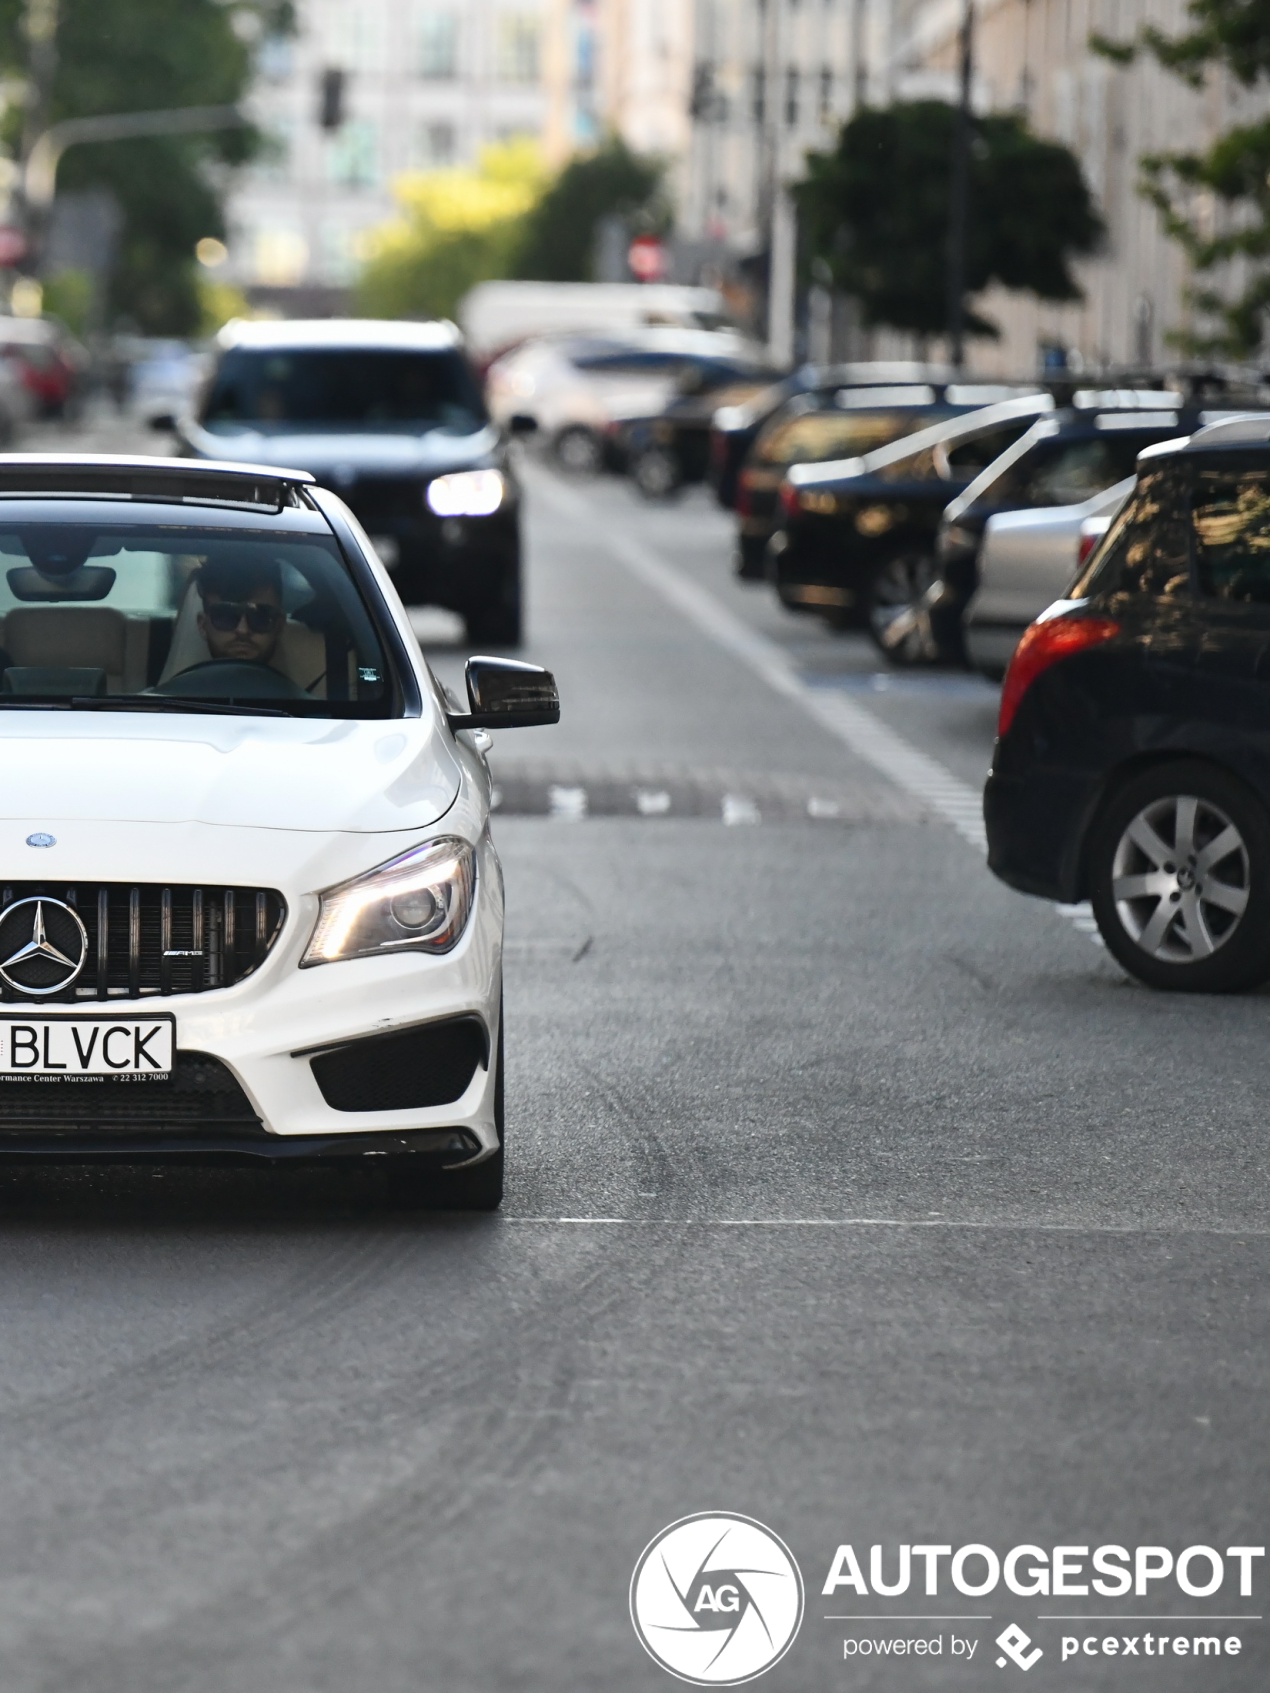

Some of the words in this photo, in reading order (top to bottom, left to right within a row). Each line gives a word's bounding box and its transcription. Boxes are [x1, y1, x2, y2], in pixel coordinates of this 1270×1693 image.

[10, 1025, 163, 1069] BLVCK
[33, 1074, 61, 1082] Center
[63, 1074, 104, 1082] Warszawa
[120, 1074, 130, 1082] 22
[132, 1073, 146, 1081] 312
[148, 1073, 169, 1081] 7000
